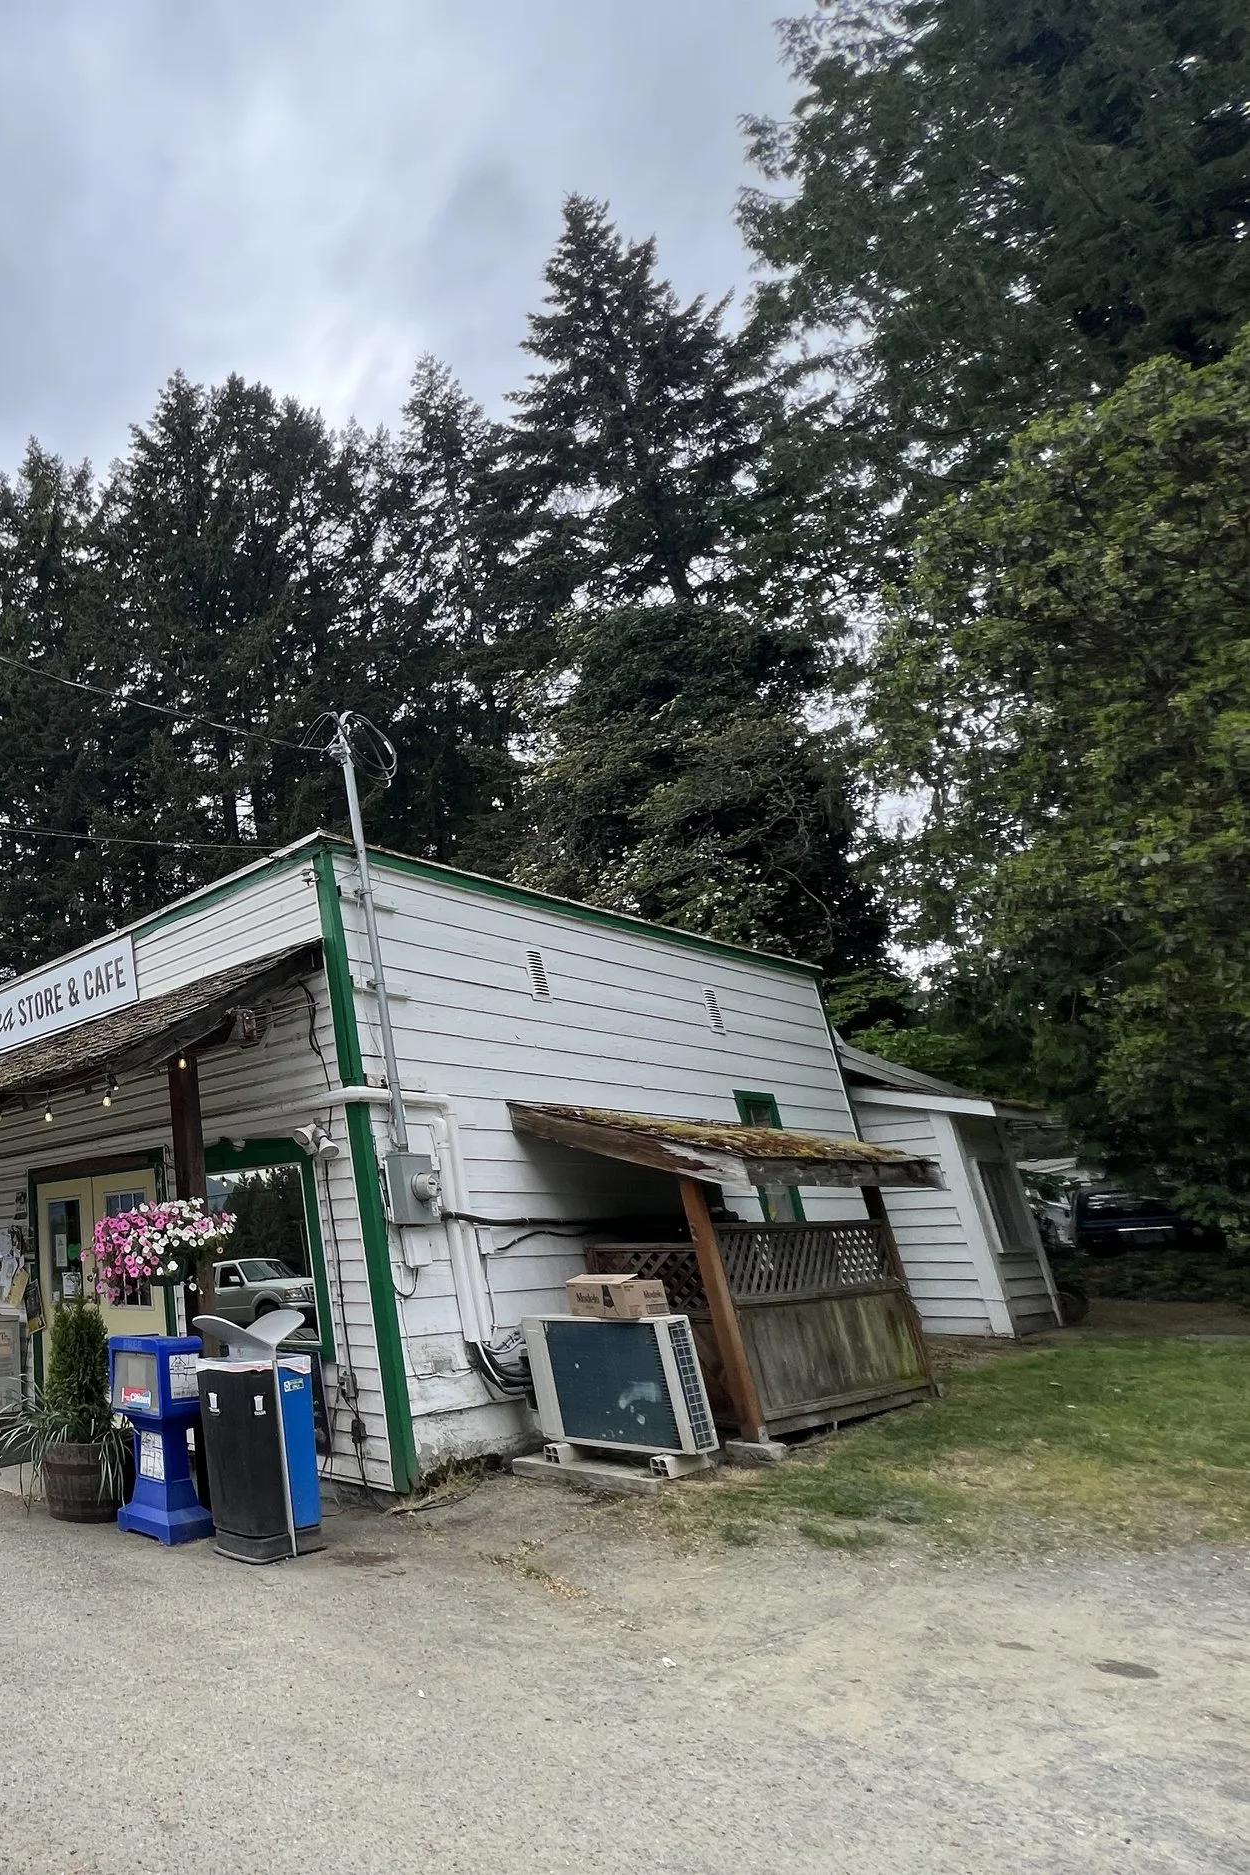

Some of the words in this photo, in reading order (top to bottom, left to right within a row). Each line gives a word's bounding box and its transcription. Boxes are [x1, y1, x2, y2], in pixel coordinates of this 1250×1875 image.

[18, 983, 64, 1027] STORE
[68, 977, 80, 1006] &
[83, 956, 127, 1001] CAFE
[576, 1291, 600, 1304] Modelo
